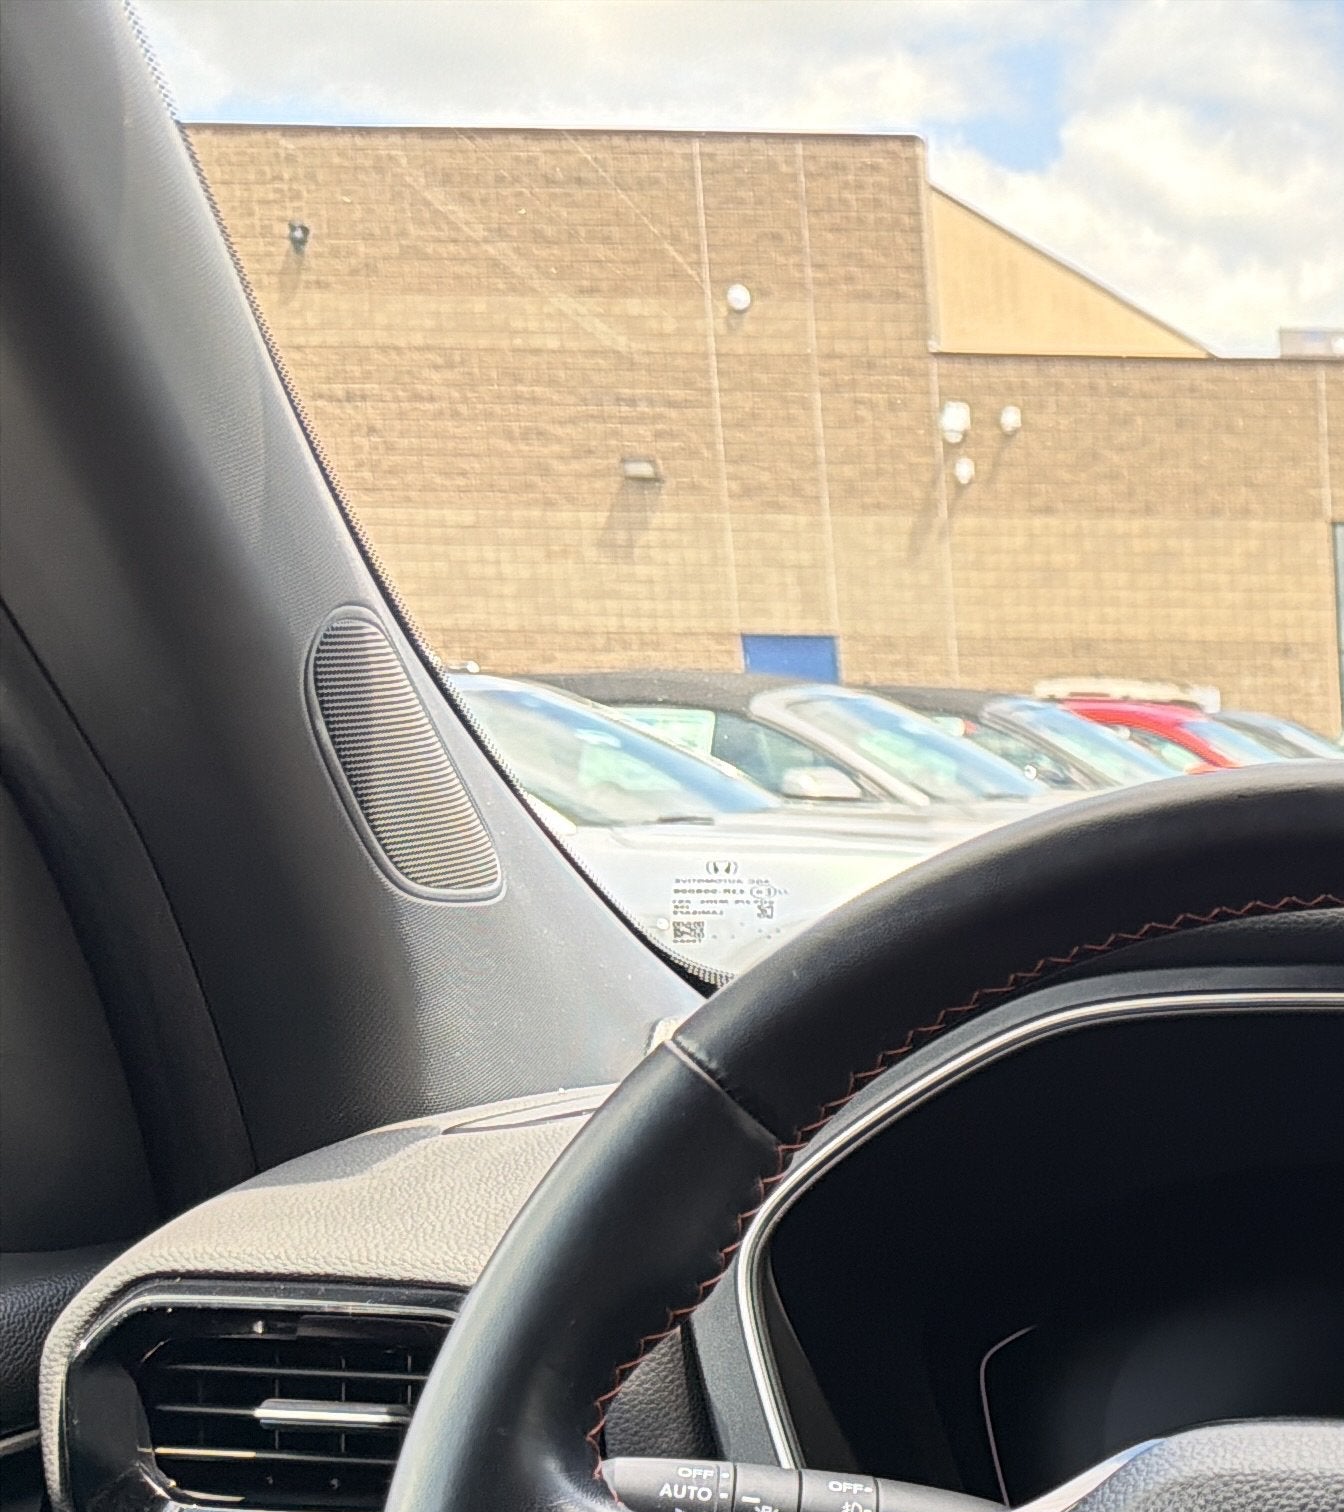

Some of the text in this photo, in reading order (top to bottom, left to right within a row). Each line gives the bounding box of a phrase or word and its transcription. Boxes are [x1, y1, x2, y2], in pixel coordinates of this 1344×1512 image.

[677, 1467, 714, 1479] OFF
[659, 1483, 713, 1501] AUTO
[828, 1480, 865, 1493] OFF
